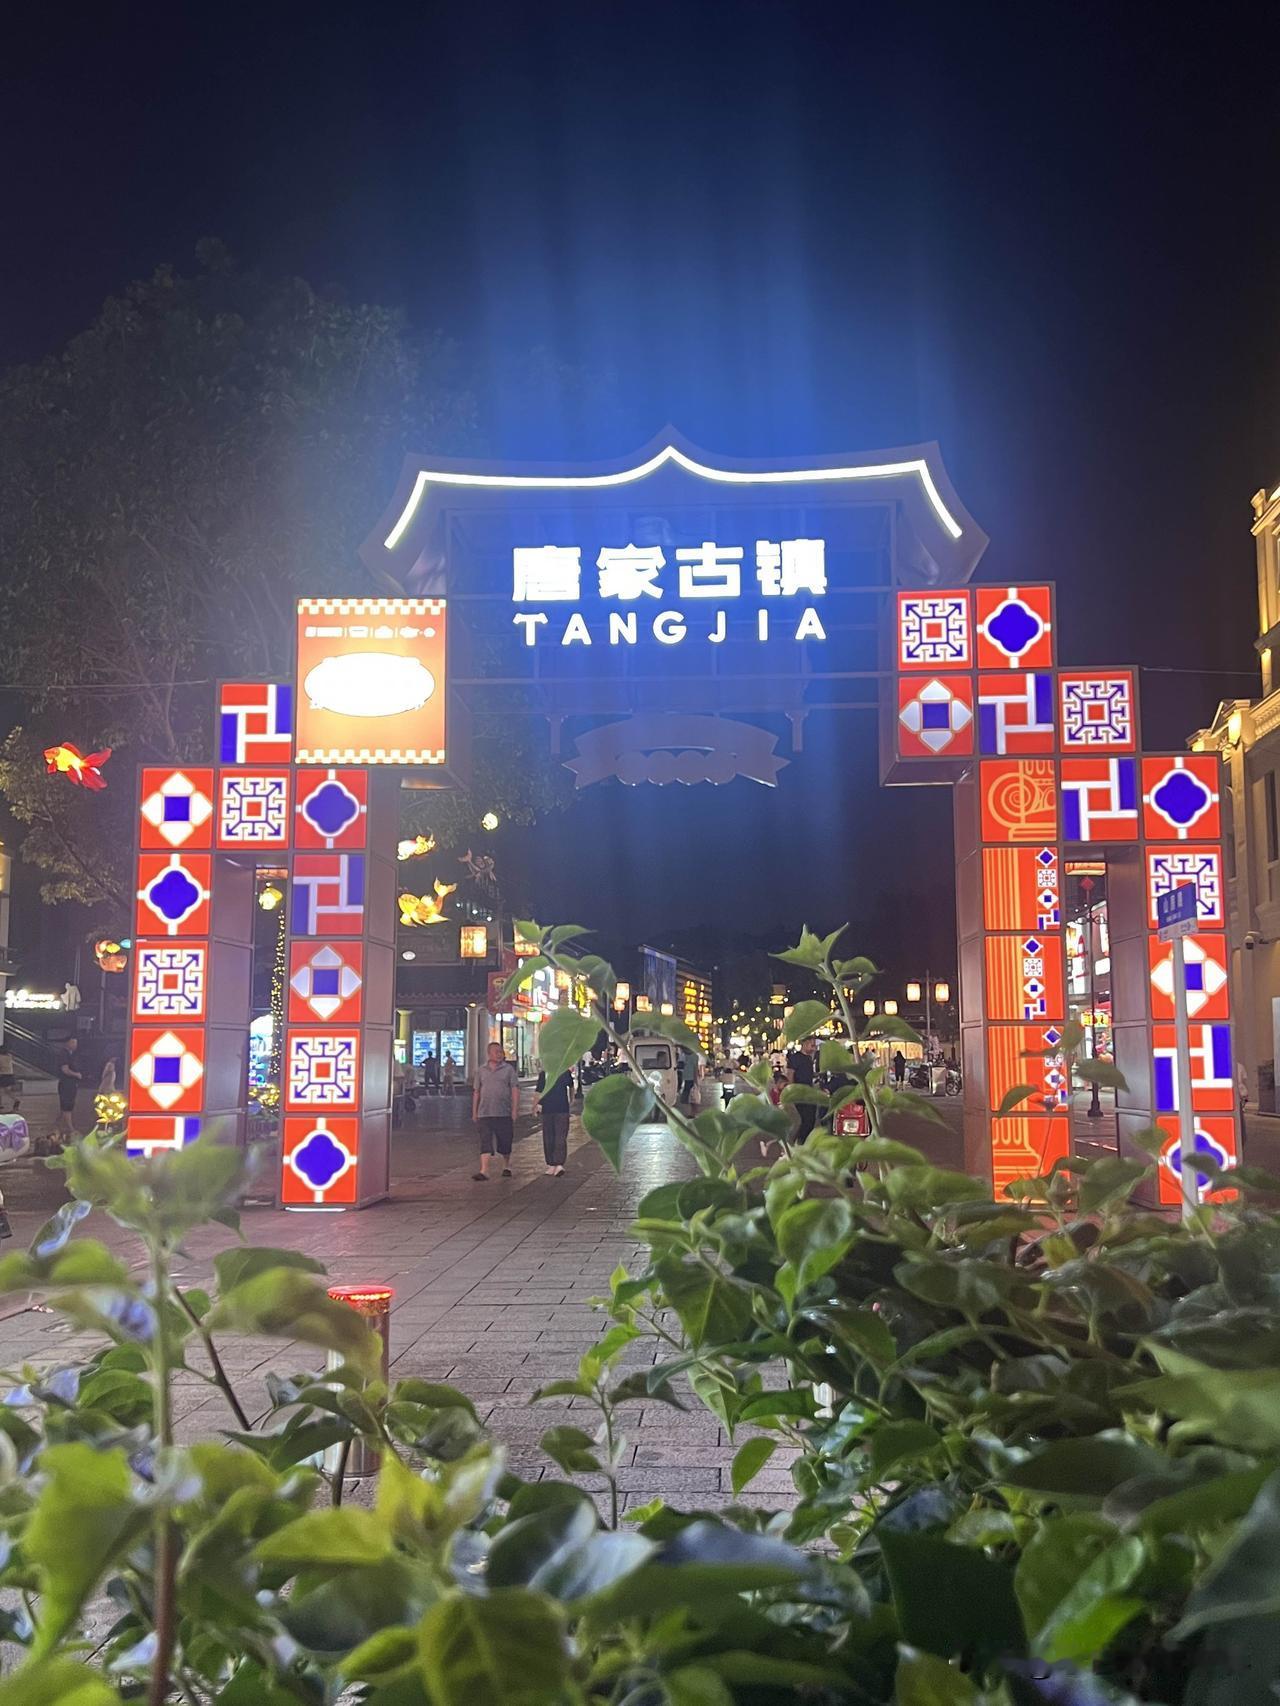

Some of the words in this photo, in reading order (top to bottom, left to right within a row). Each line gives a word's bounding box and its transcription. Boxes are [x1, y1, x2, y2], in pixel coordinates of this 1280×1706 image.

[512, 539, 828, 602] 唐家古镇
[513, 608, 827, 646] TANGJIA
